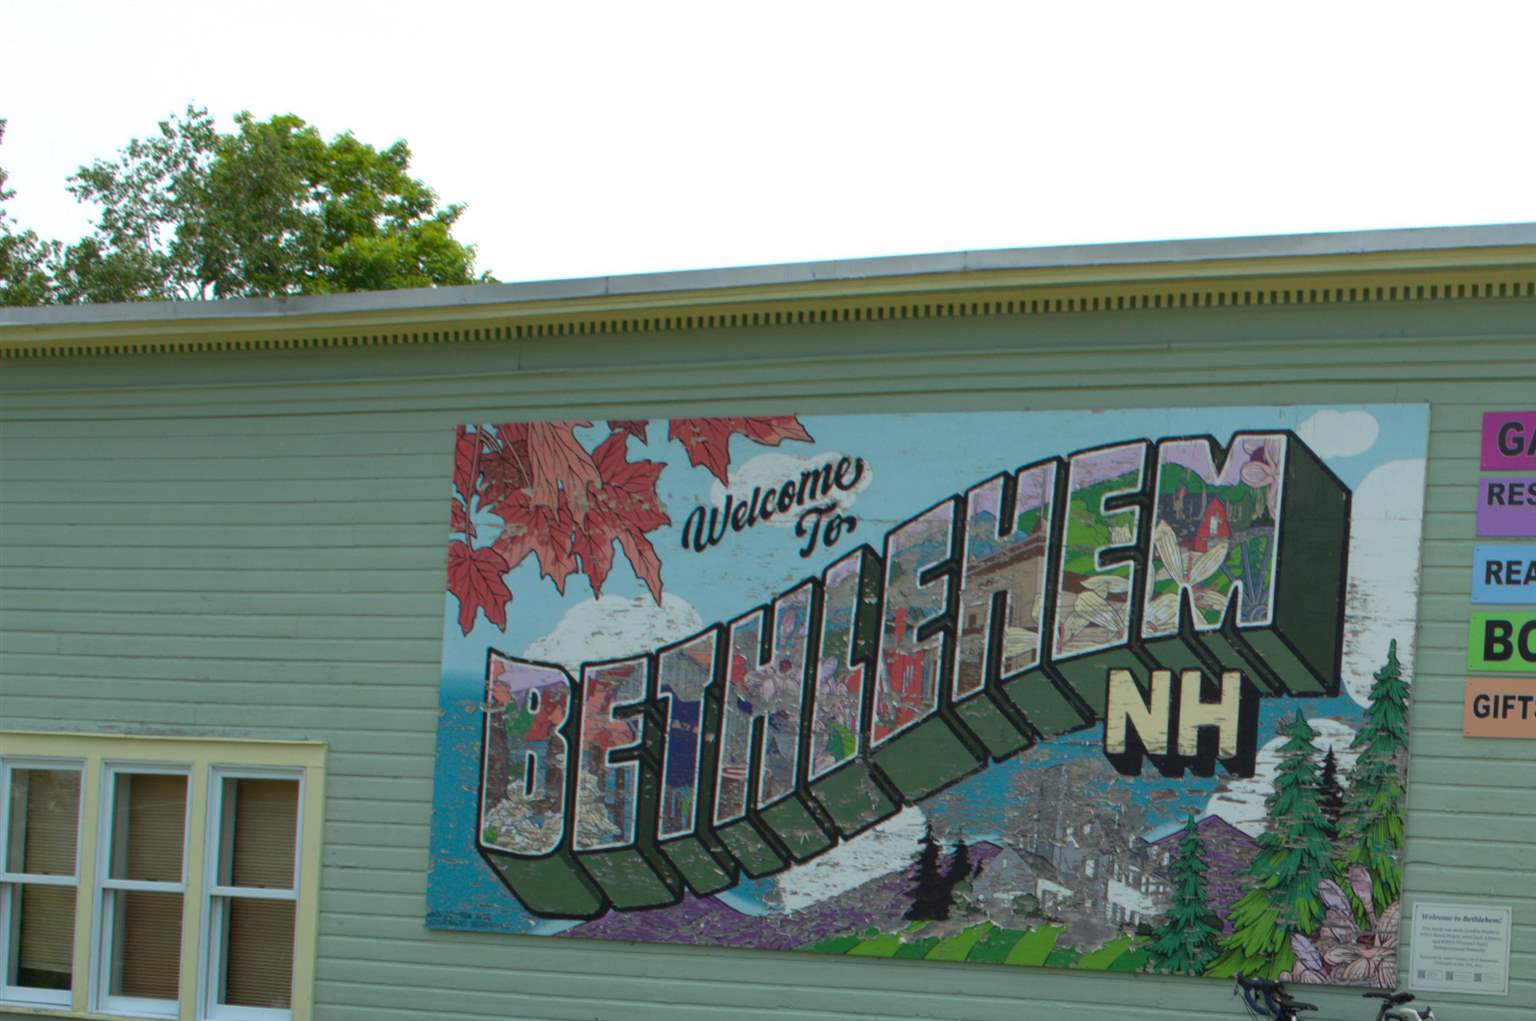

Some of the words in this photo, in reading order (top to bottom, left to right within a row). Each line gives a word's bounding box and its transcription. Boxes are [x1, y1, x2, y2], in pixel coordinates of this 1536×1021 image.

[681, 456, 864, 553] Welcome
[795, 502, 857, 558] To
[477, 429, 1294, 859] BETHLEHEM
[1105, 668, 1247, 758] NH
[1422, 913, 1452, 921] Welcome
